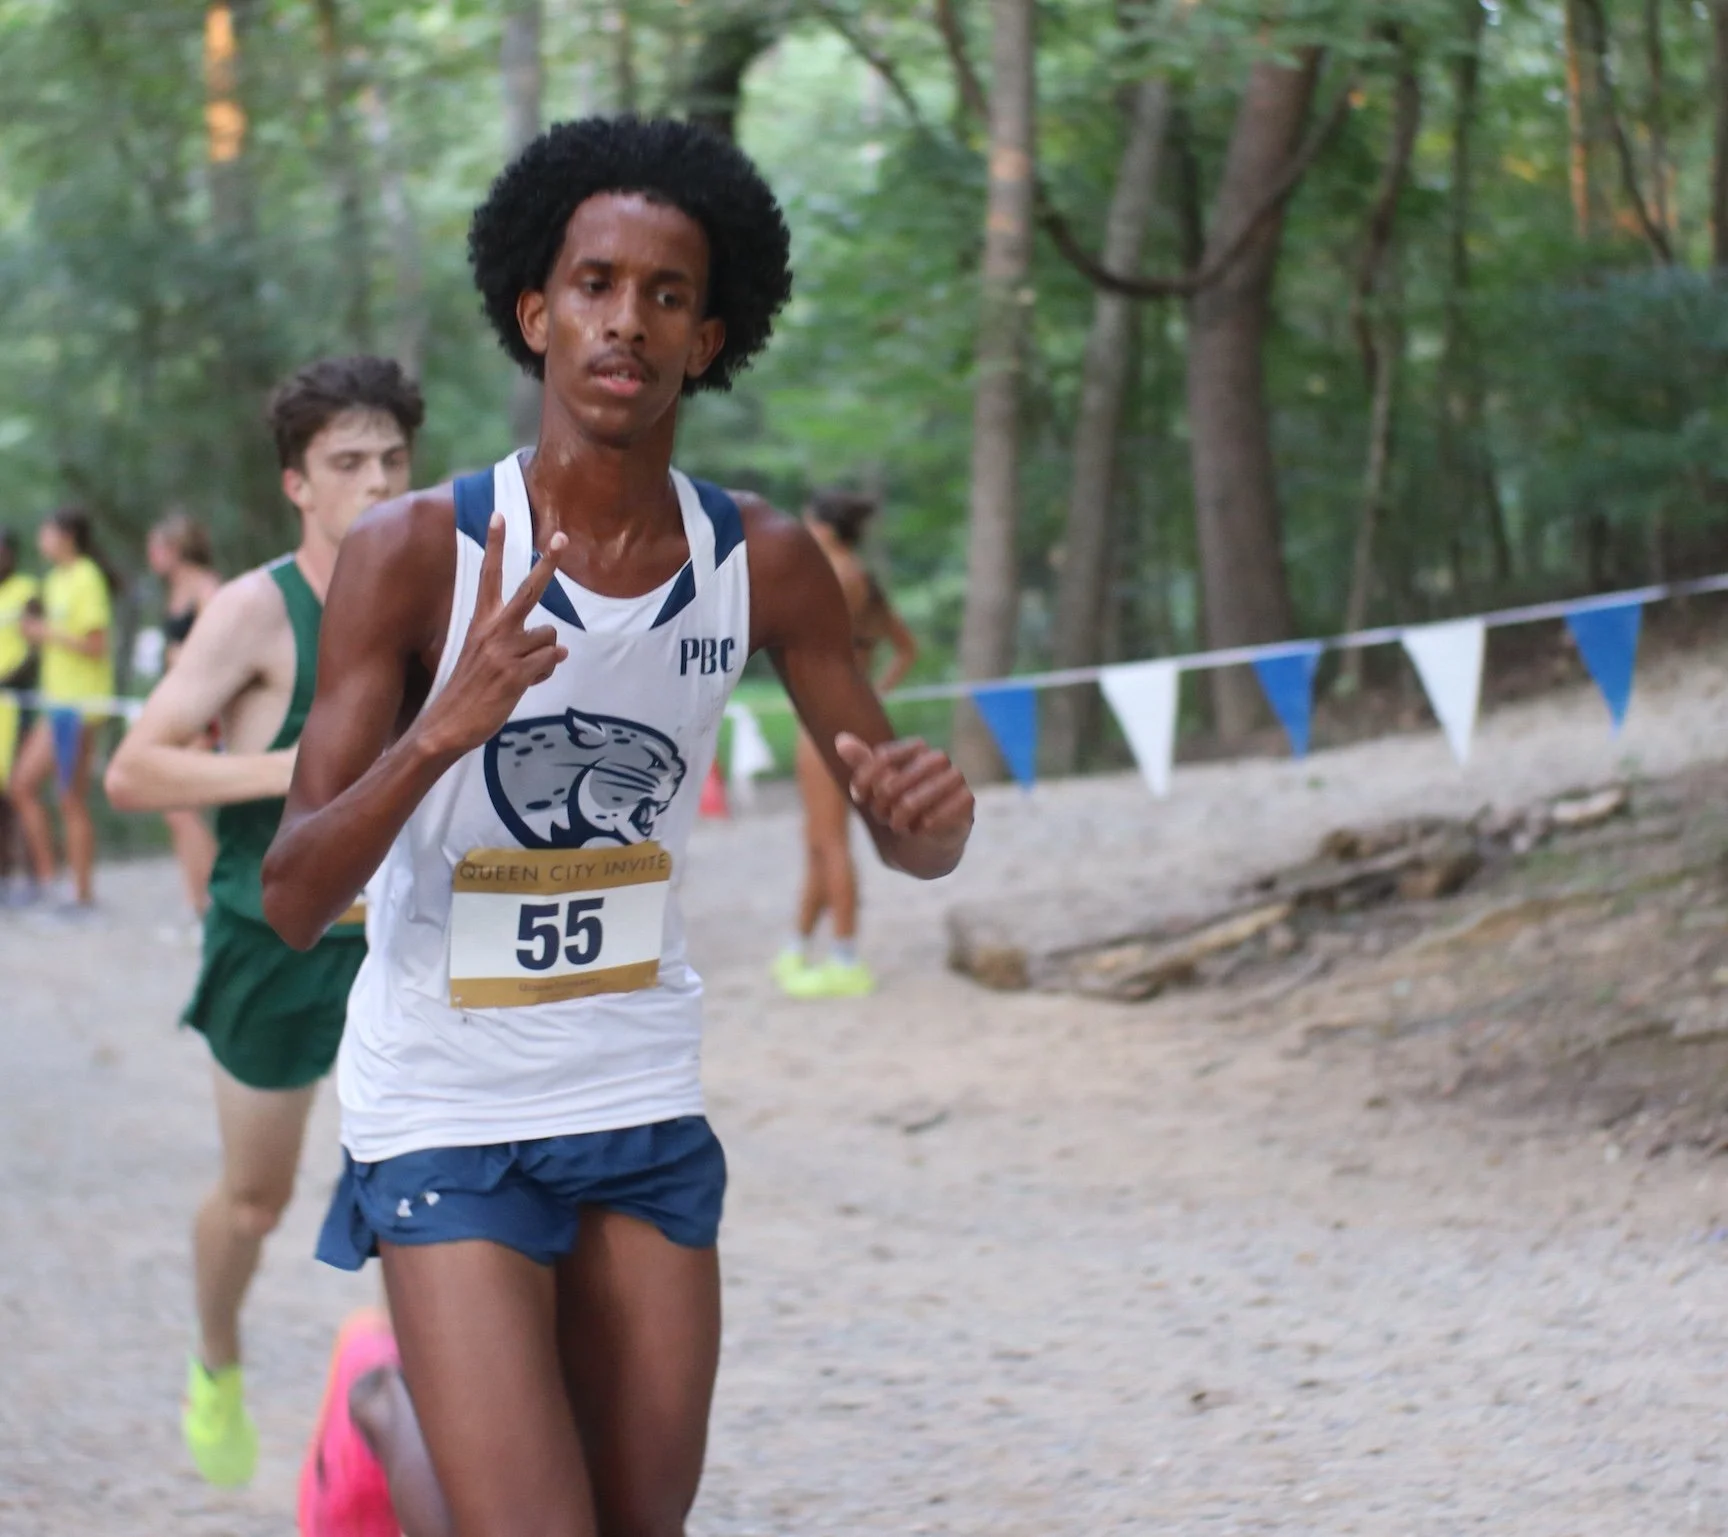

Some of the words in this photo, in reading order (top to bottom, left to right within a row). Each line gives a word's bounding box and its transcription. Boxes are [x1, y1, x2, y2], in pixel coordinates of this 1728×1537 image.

[680, 637, 735, 676] PBC
[459, 861, 539, 882] QUEEN
[549, 863, 596, 881] CITY
[604, 852, 668, 876] INVITE
[516, 897, 605, 971] 55
